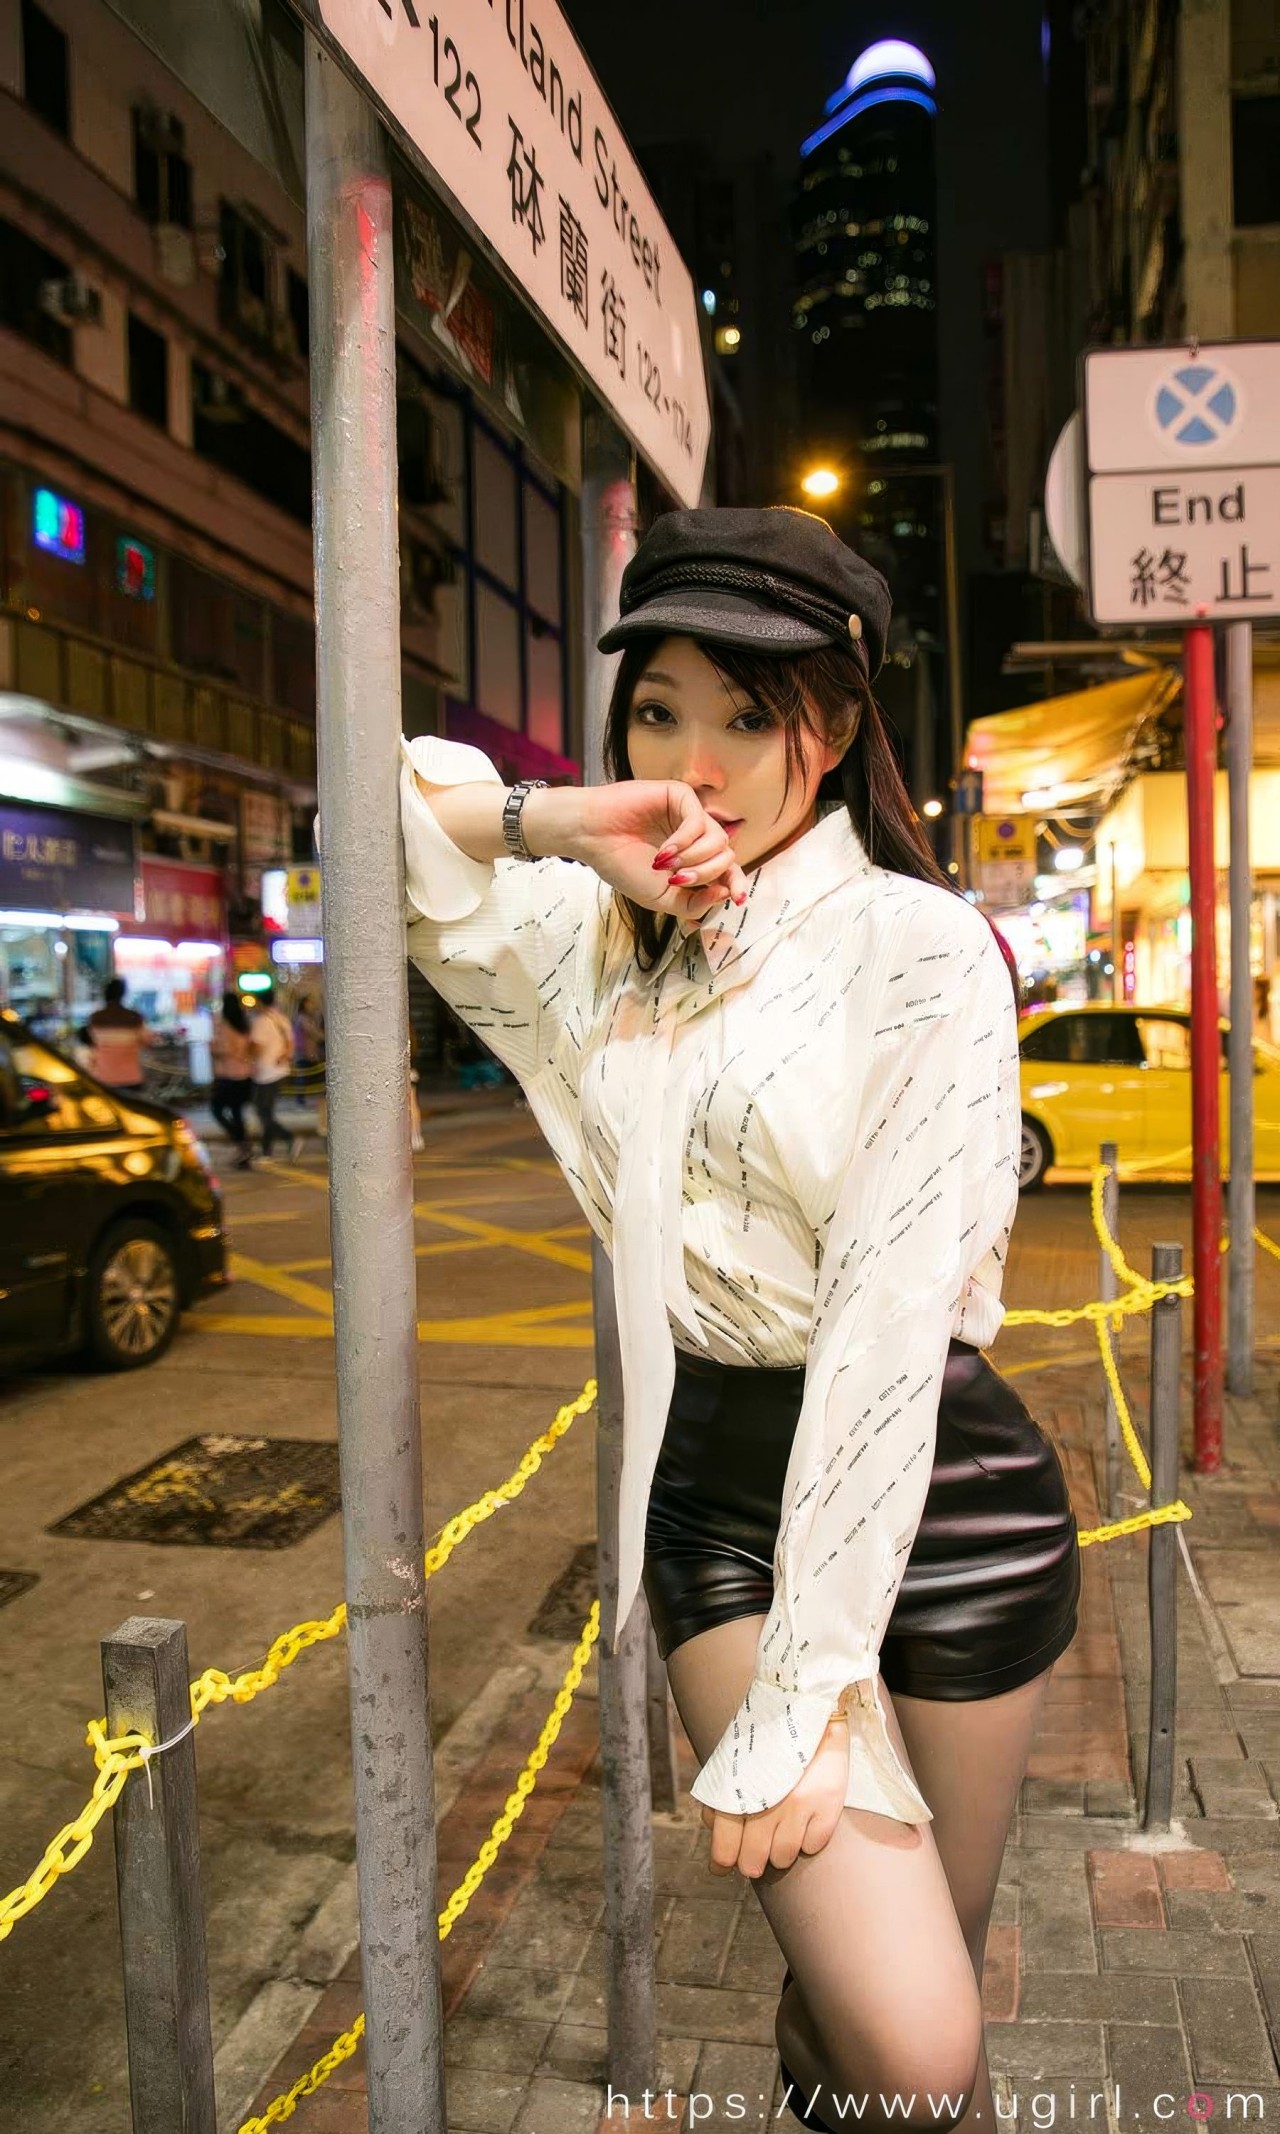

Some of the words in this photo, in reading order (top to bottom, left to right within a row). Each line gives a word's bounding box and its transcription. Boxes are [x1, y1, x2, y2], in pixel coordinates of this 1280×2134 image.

[506, 112, 626, 381] 砵蘭街
[594, 126, 662, 308] Street
[1153, 483, 1245, 525] End
[1130, 545, 1273, 607] 終止
